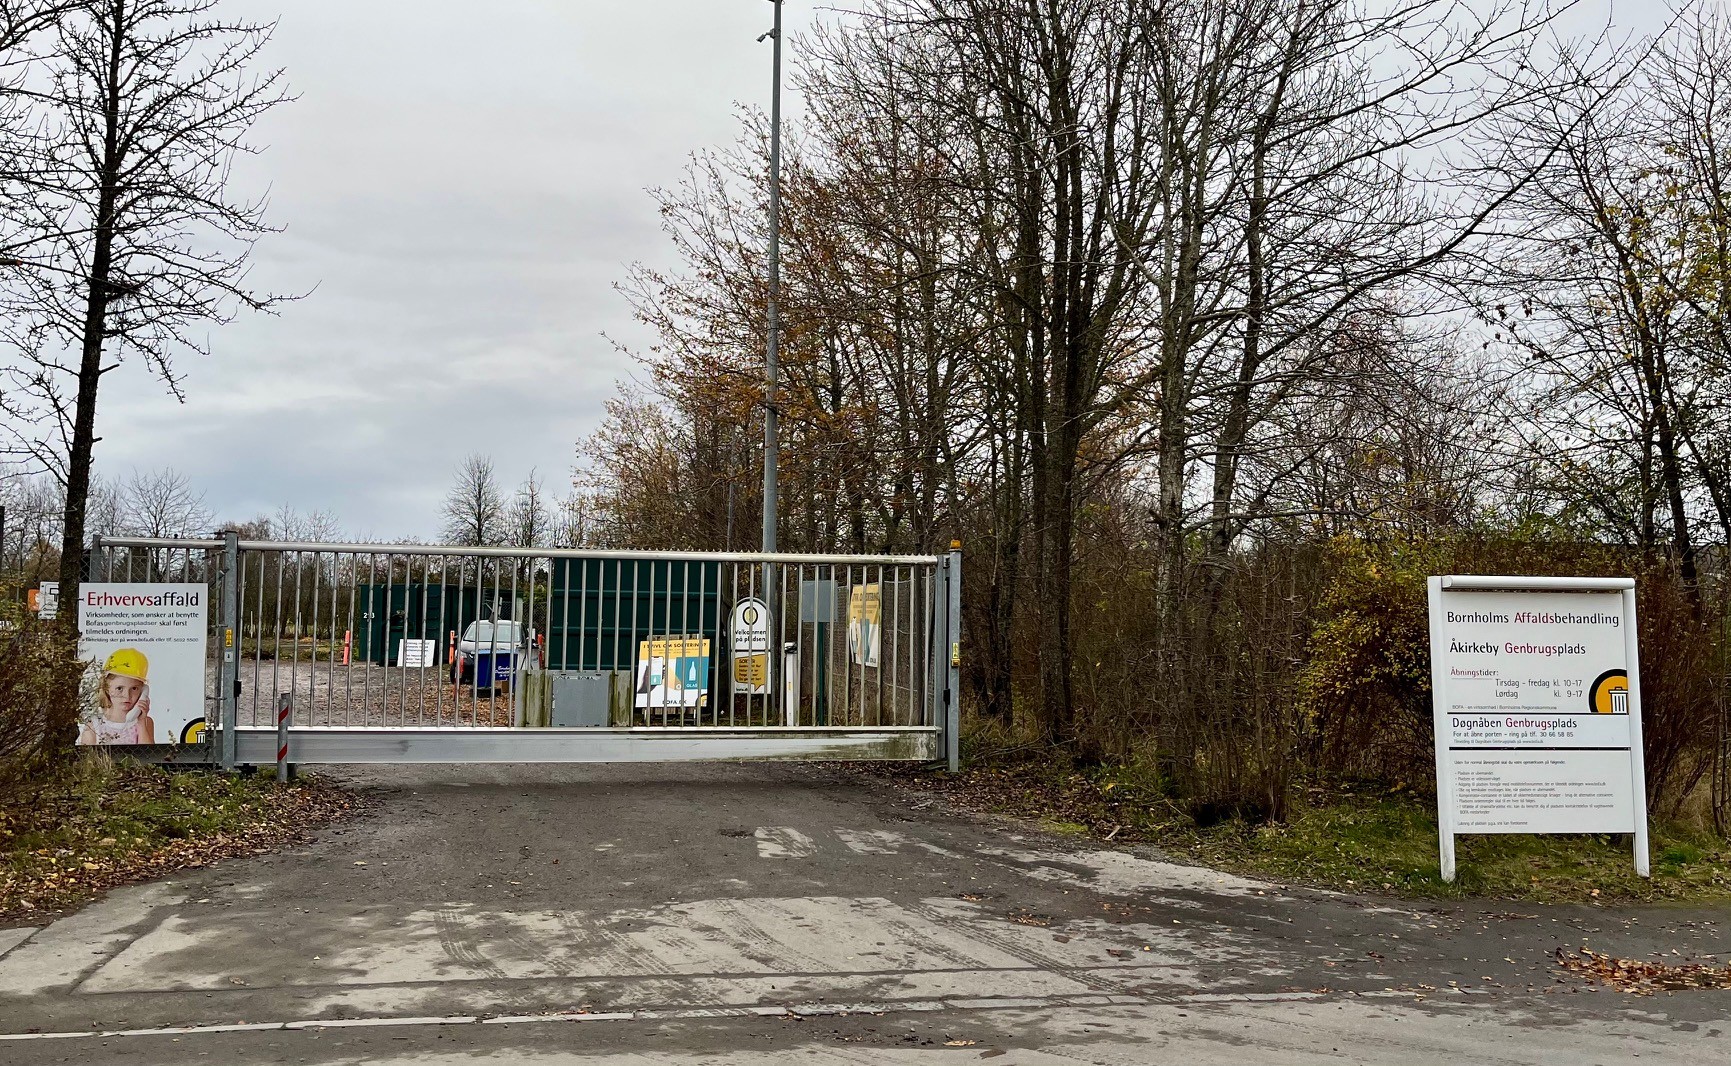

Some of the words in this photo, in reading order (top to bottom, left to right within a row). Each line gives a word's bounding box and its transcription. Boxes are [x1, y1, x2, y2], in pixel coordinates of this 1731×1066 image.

[87, 591, 199, 607] Erhvervsaffald
[86, 611, 130, 619] Virksomheder,
[175, 611, 199, 619] benytte
[1447, 611, 1509, 623] Bornholms
[1514, 612, 1619, 627] Affaldsbehandling
[1450, 637, 1499, 656] Åkirkeby
[1504, 642, 1586, 657] Genbrugsplads
[1450, 666, 1499, 677] Åbningstider:
[1495, 679, 1520, 688] Tirsdag
[1528, 679, 1550, 688] fredag
[1563, 679, 1582, 687] 10-17
[1495, 690, 1519, 699] Lørdag
[1566, 690, 1583, 698] 9-17
[1452, 717, 1502, 730] Døgnåben
[1505, 717, 1577, 730] Genbrugsplads
[1485, 731, 1502, 739] porten
[1509, 731, 1520, 739] ring
[1521, 731, 1528, 739] på
